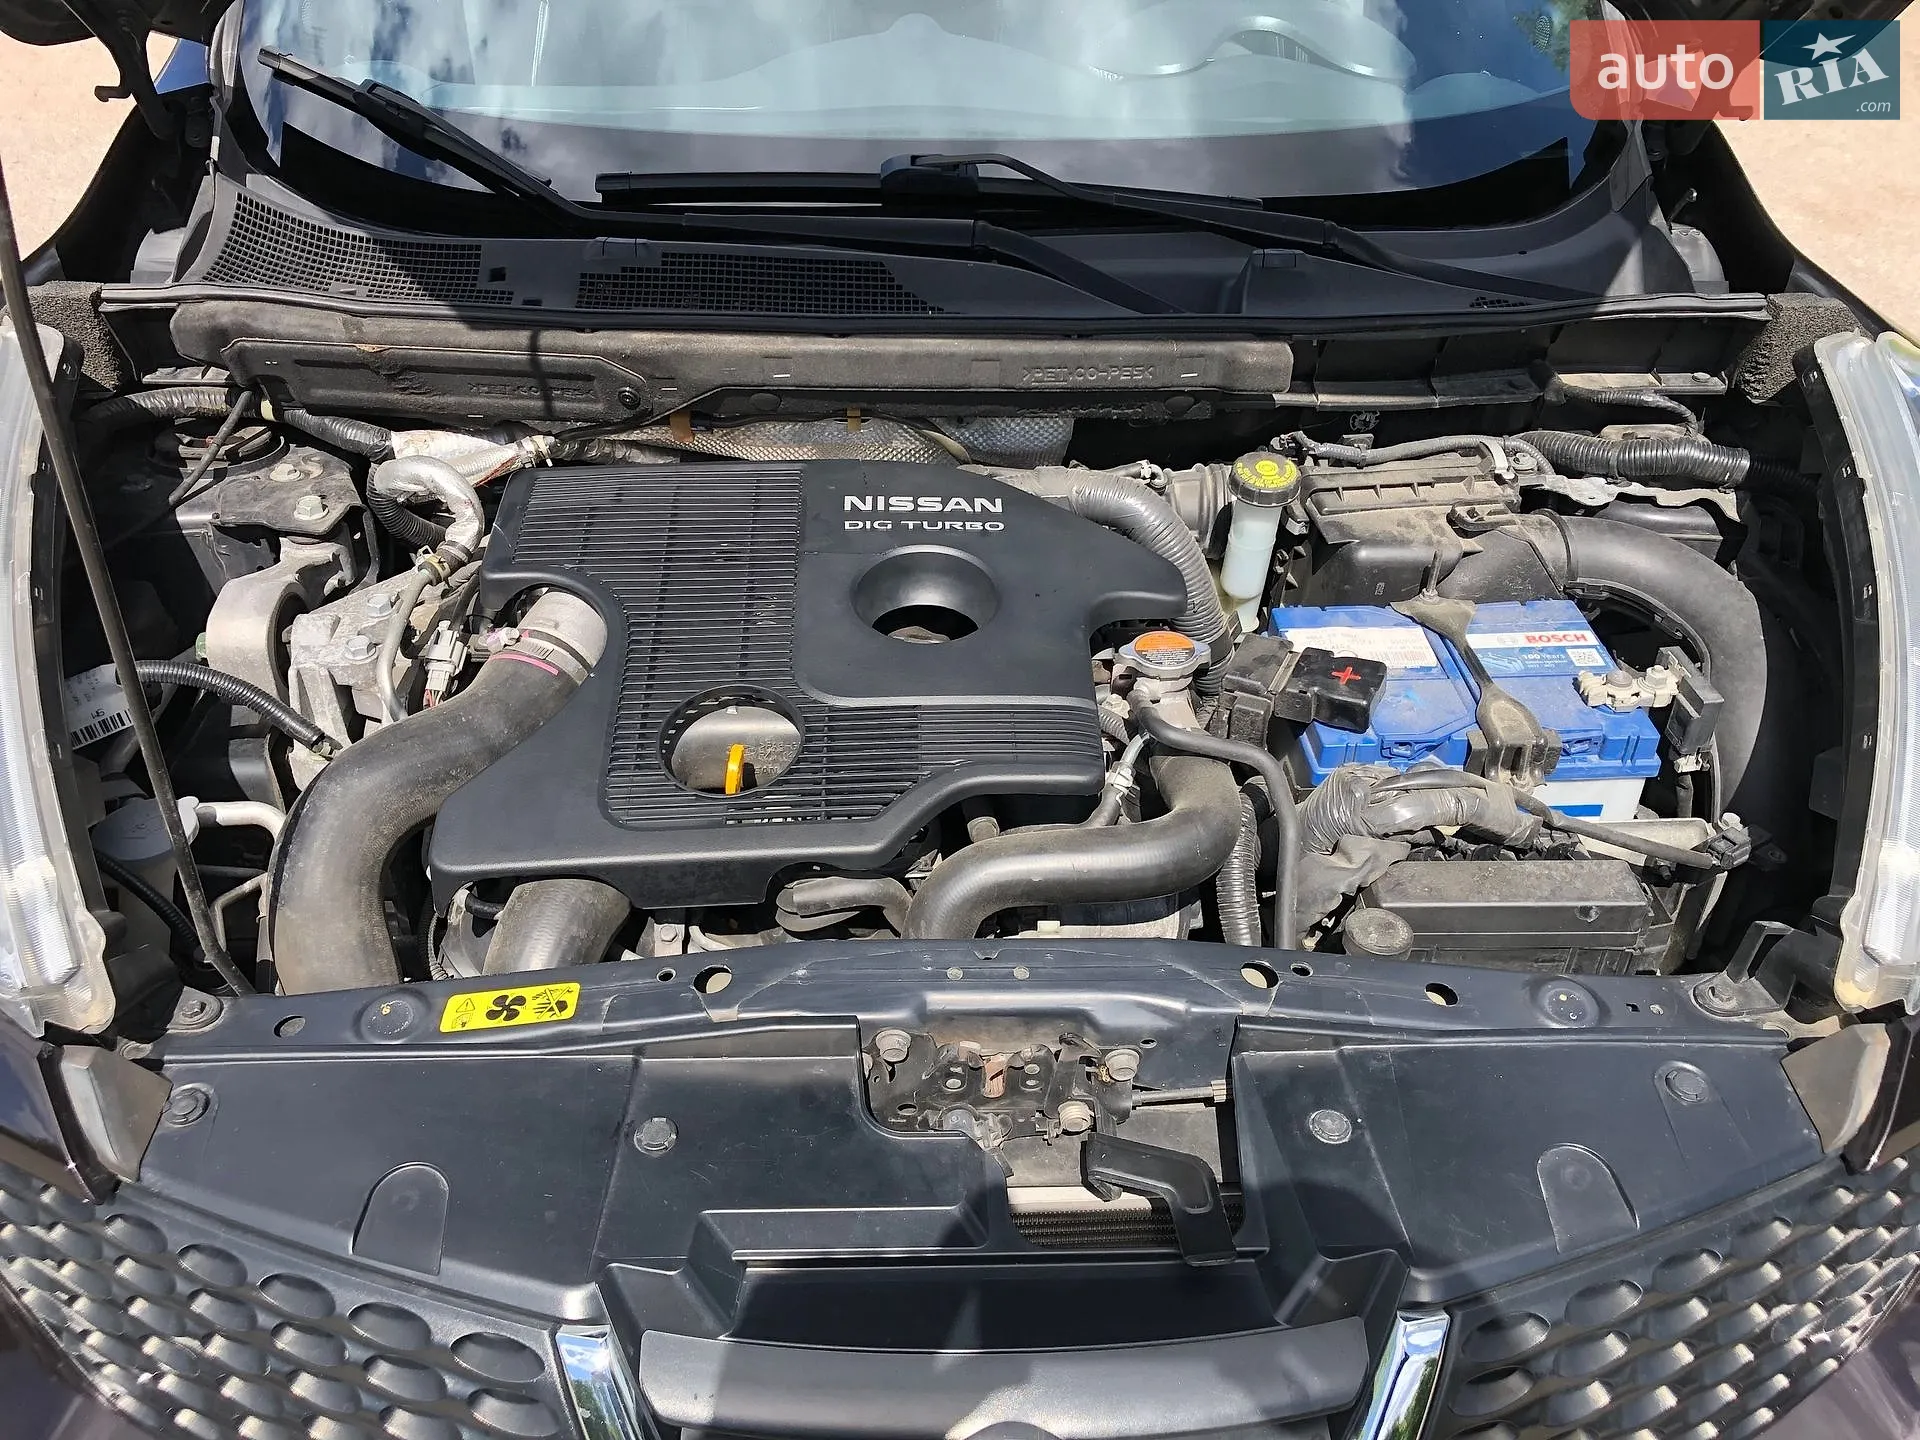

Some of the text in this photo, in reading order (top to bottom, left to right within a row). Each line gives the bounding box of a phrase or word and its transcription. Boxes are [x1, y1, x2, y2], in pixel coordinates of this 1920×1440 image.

[843, 495, 1004, 513] NISSAN
[843, 520, 1006, 532] DIG TURBO
[1525, 633, 1588, 644] BOSCH
